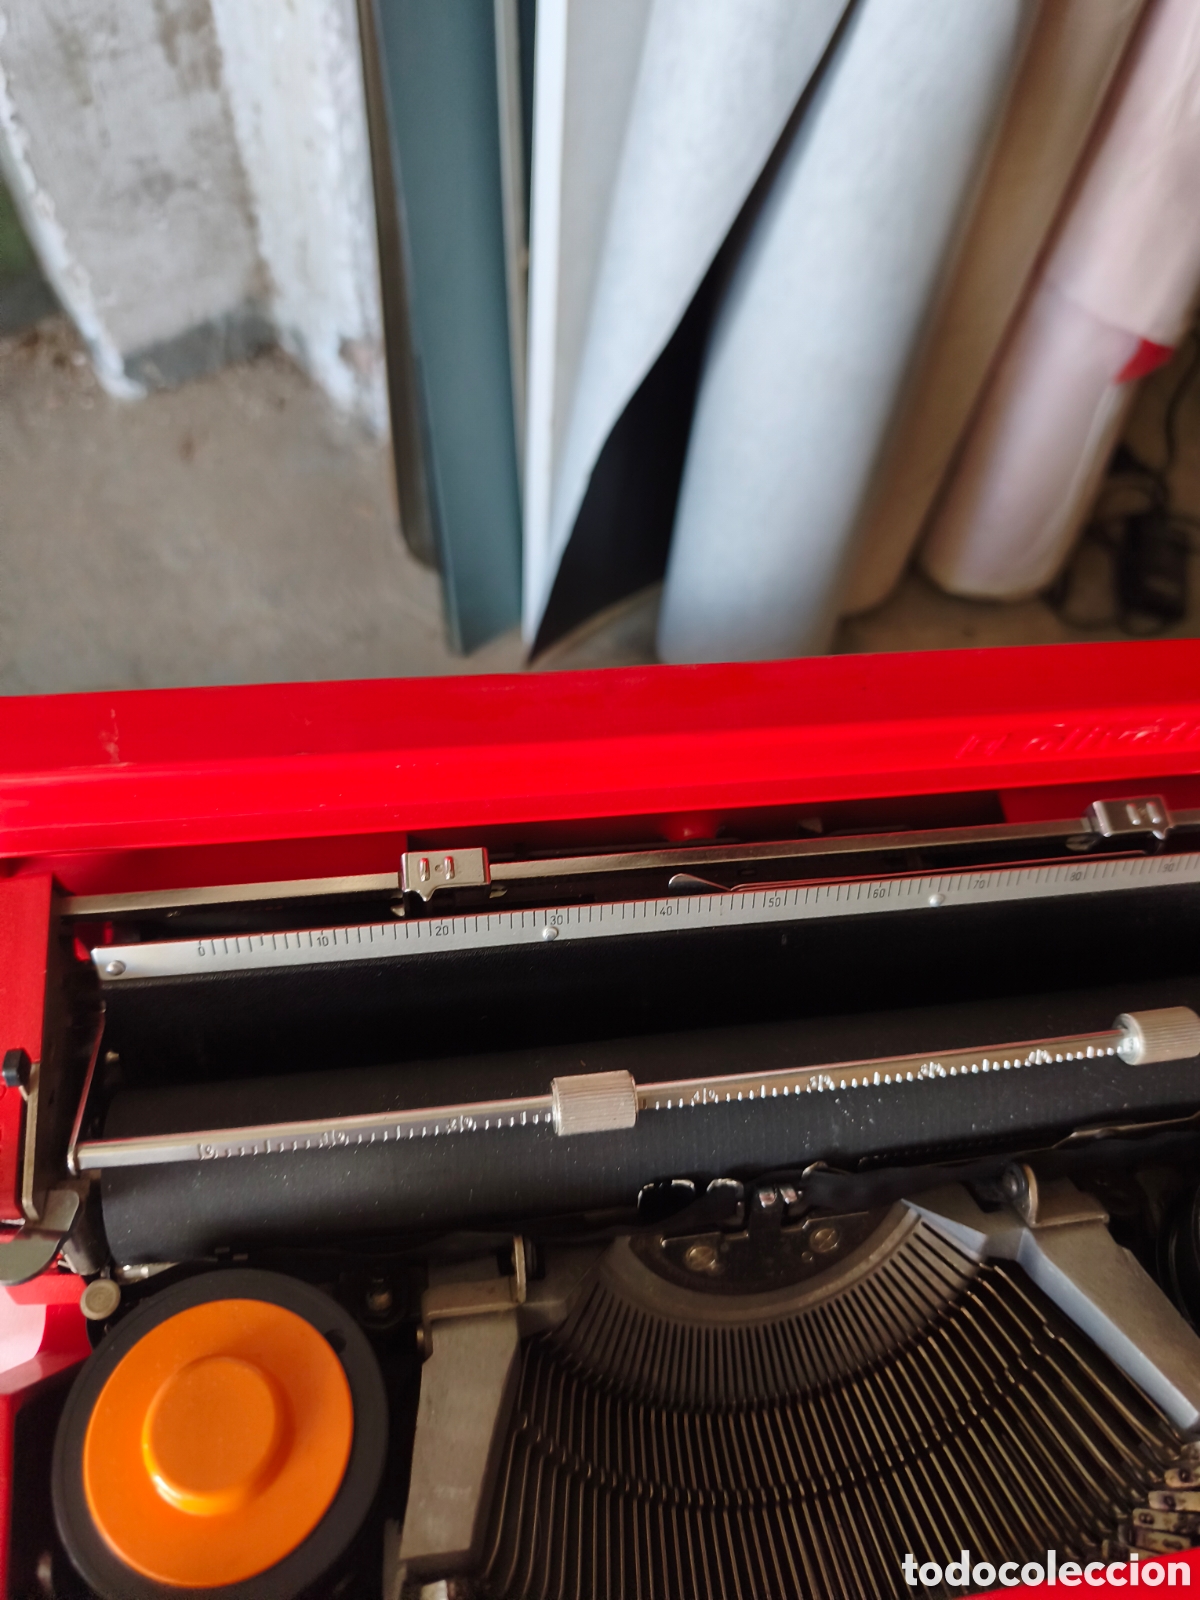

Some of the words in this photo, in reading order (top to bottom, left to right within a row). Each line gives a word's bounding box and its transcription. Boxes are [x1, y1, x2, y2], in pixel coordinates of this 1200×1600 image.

[198, 945, 206, 957] 0
[316, 935, 329, 947] 10
[435, 925, 449, 937] 20
[550, 914, 564, 926] 30
[659, 905, 673, 916] 40
[768, 897, 781, 908] 50
[872, 888, 886, 899] 60
[973, 879, 985, 889] 70
[1070, 871, 1083, 882] 80
